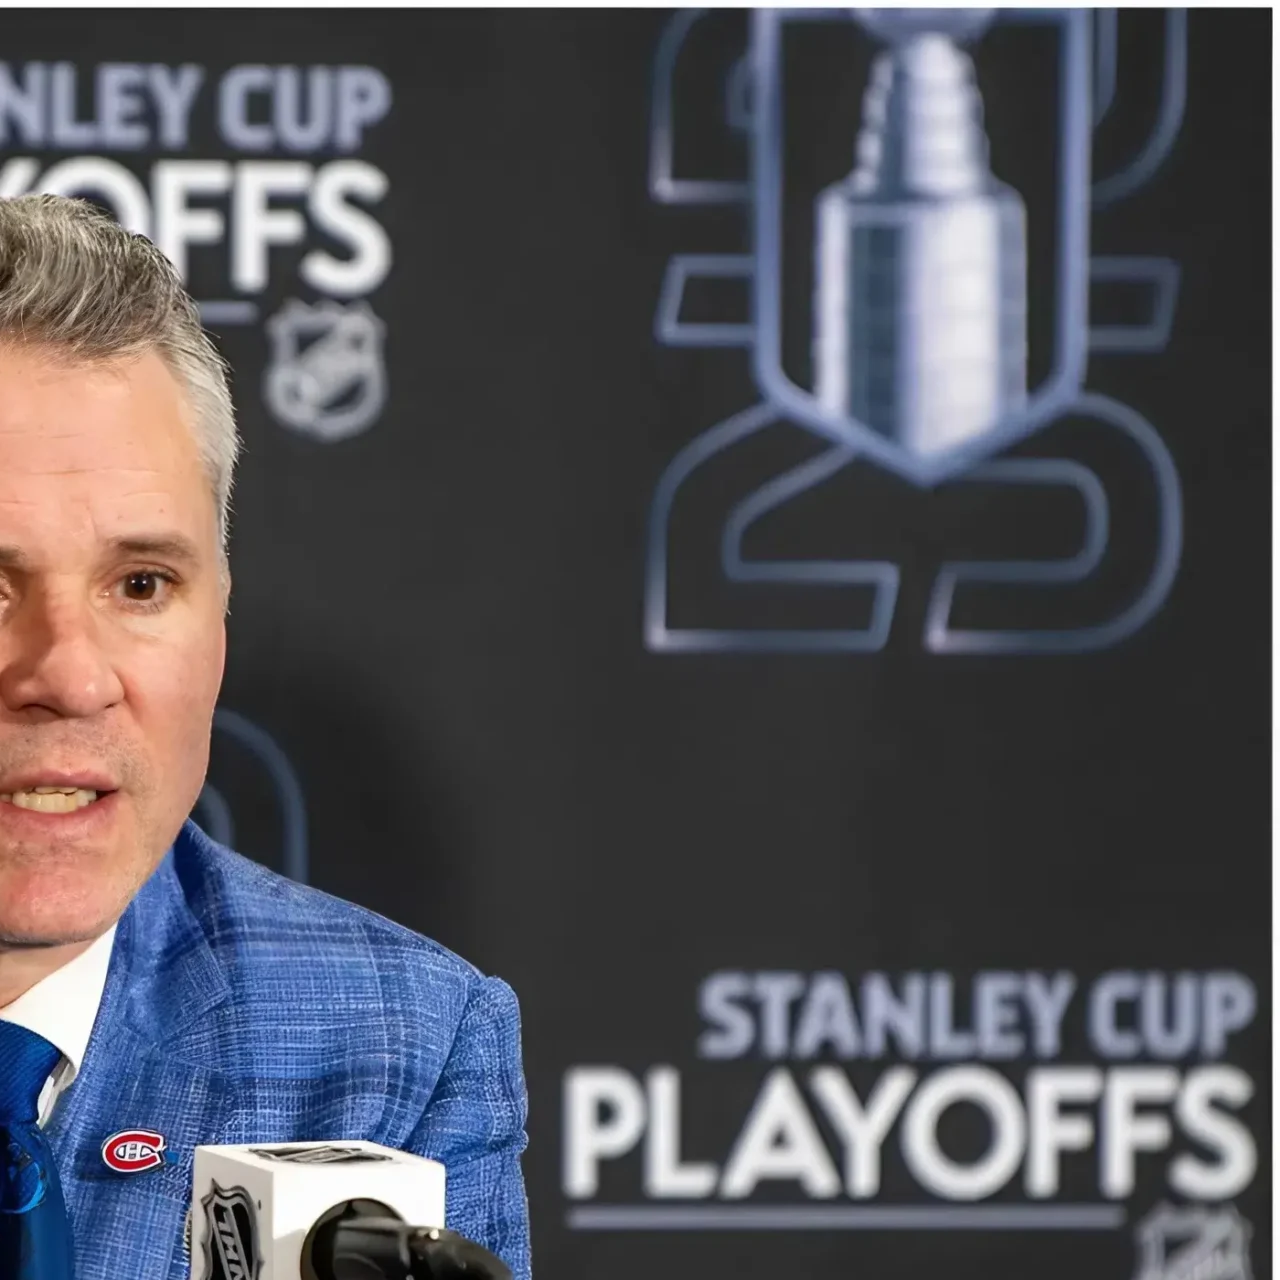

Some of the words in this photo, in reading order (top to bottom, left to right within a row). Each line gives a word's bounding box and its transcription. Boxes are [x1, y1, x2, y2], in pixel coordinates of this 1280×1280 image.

[218, 64, 392, 151] CUP
[699, 971, 1076, 1059] STANLEY
[1088, 971, 1257, 1059] CUP
[562, 1063, 1258, 1201] PLAYOFFS
